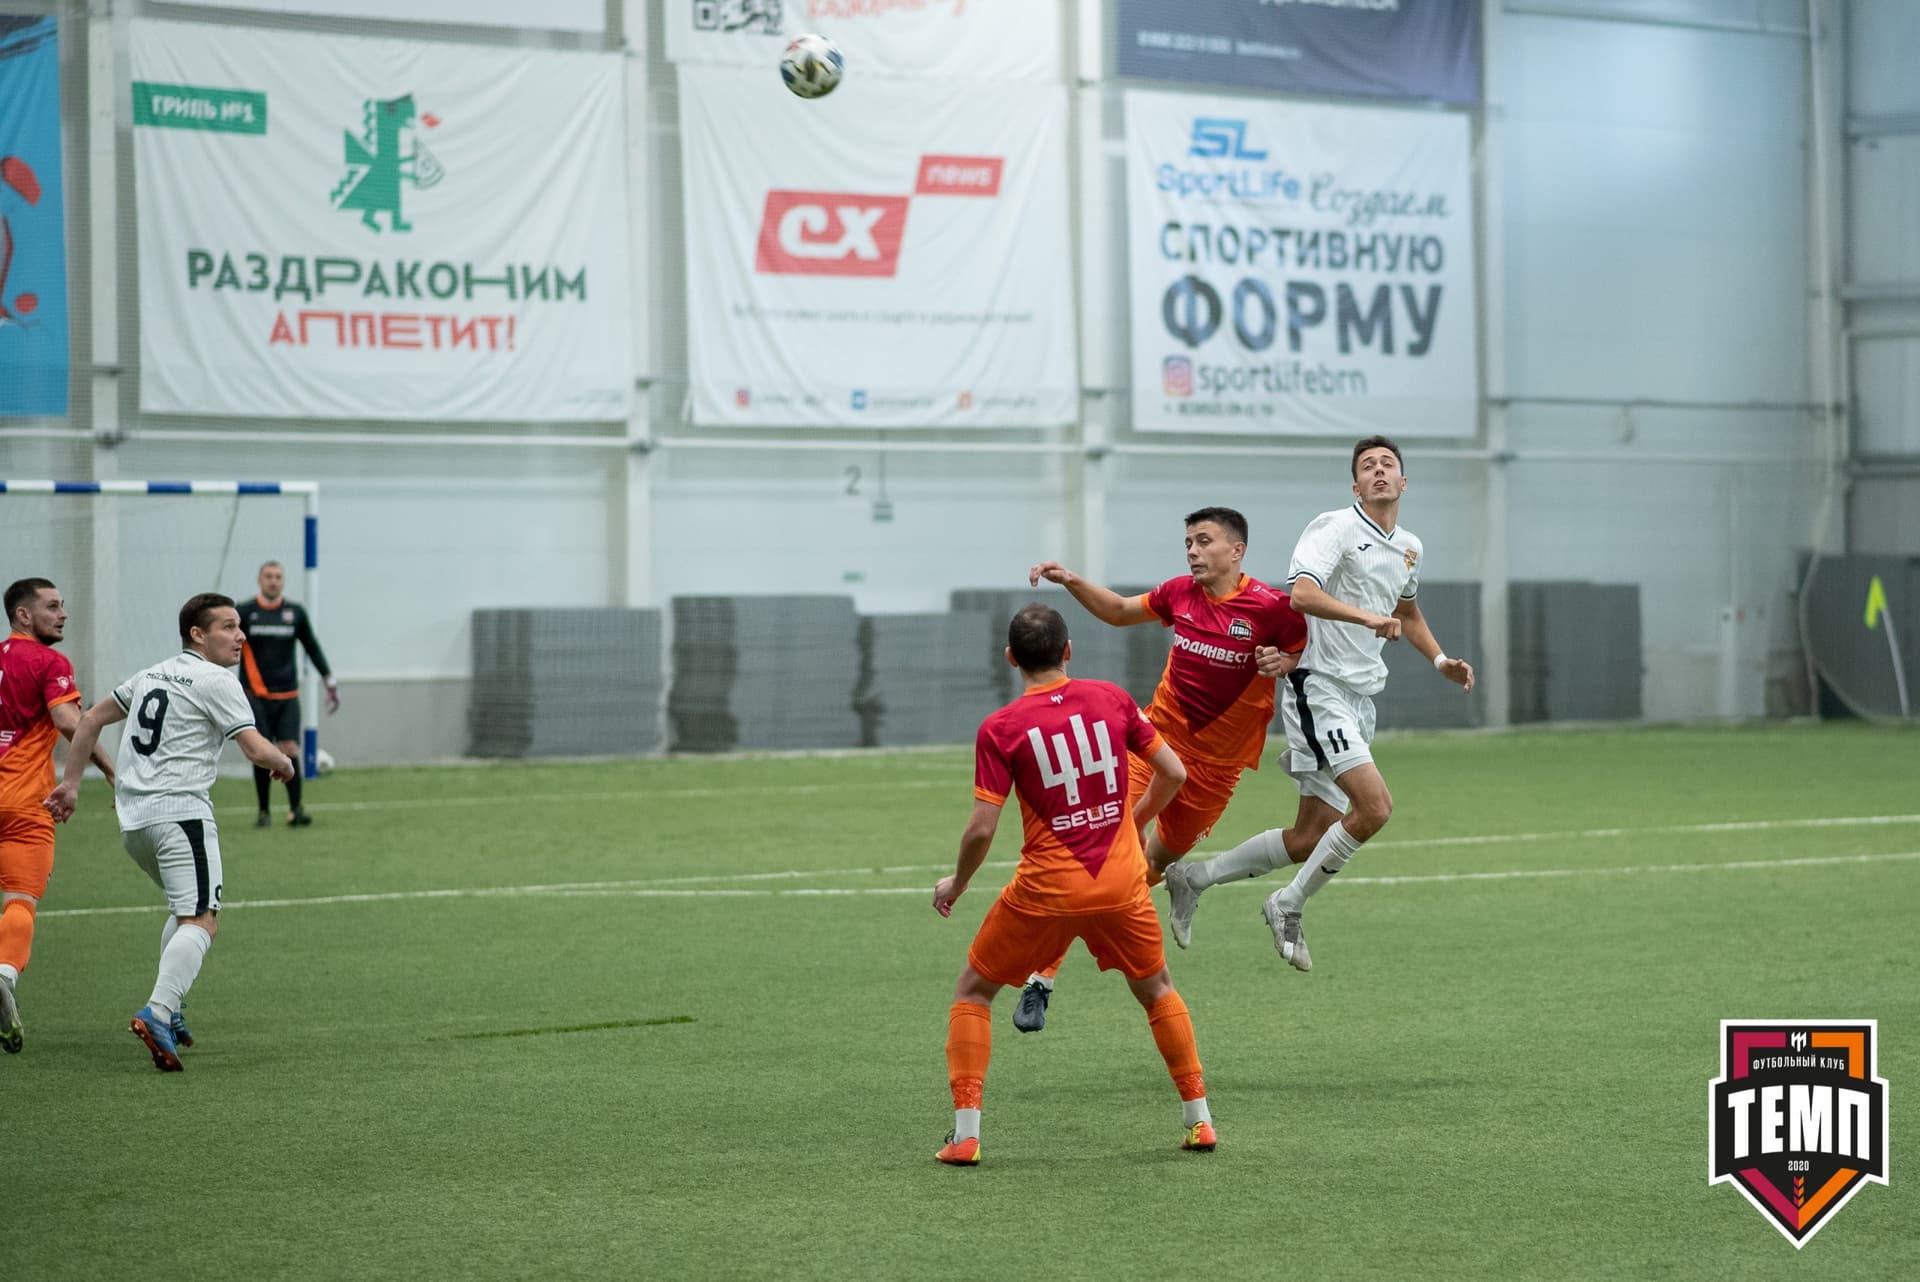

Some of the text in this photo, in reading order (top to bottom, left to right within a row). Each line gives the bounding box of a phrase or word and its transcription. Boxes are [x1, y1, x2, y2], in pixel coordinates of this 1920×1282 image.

[152, 95, 217, 119] ГРИЛЬ
[926, 165, 993, 187] news
[1159, 220, 1444, 274] СПОРТИВНУЮ
[186, 250, 588, 303] РАЗДРАКОНИМ
[269, 310, 517, 350] АППЕТИТ!
[1161, 273, 1444, 356] ФОРМУ
[1198, 362, 1368, 398] sportlifebrn
[844, 465, 862, 496] 2
[131, 688, 169, 756] 9
[1327, 728, 1350, 754] 11
[1027, 714, 1118, 806] 44
[1052, 800, 1120, 831] SEUS
